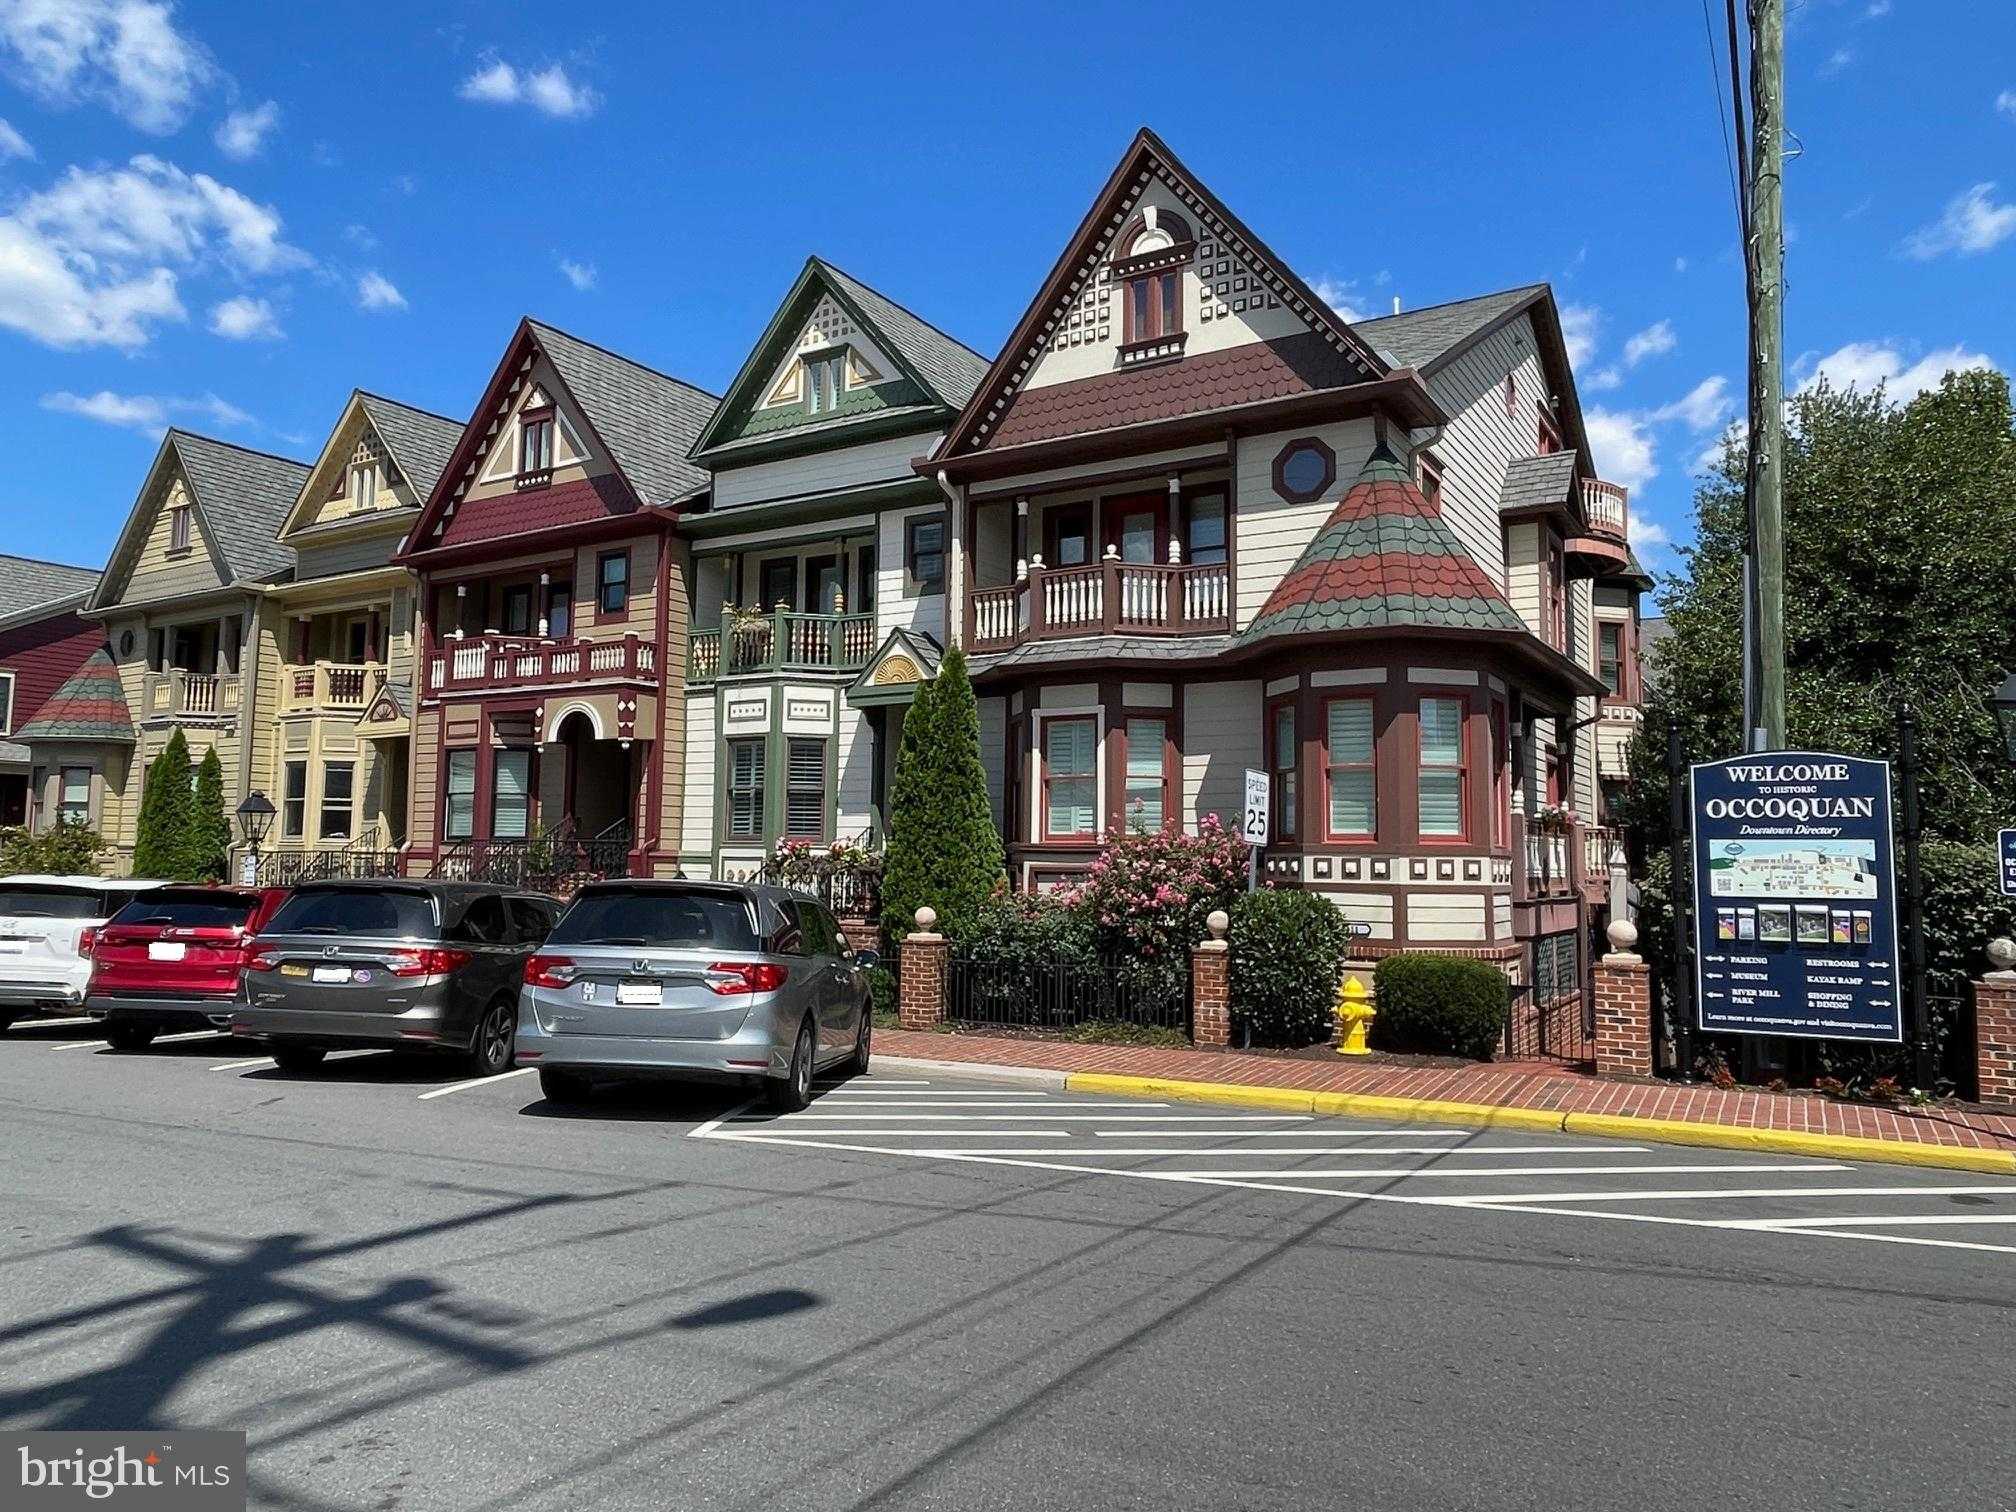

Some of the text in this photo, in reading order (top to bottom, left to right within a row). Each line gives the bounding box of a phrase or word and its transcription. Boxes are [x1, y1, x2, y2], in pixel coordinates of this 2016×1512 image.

[1726, 764, 1849, 782] WELCOME
[1248, 779, 1268, 793] SPEED
[1758, 786, 1817, 794] TO HISTORIC
[1249, 794, 1266, 807] LIMIT
[1706, 797, 1875, 821] OCCOQUAN
[1246, 808, 1266, 837] 25
[1740, 825, 1841, 837] Downtown Directory
[1730, 956, 1768, 965] PARKING
[1806, 959, 1860, 968] RESTROOMS
[1730, 972, 1768, 980] MUSEUM
[1807, 975, 1864, 985] KAYAK RAMP
[1732, 988, 1781, 998] RIVER MILL
[1807, 992, 1853, 1001] SHOPPING
[1732, 997, 1754, 1005] PARK
[1816, 1001, 1850, 1010] DINING
